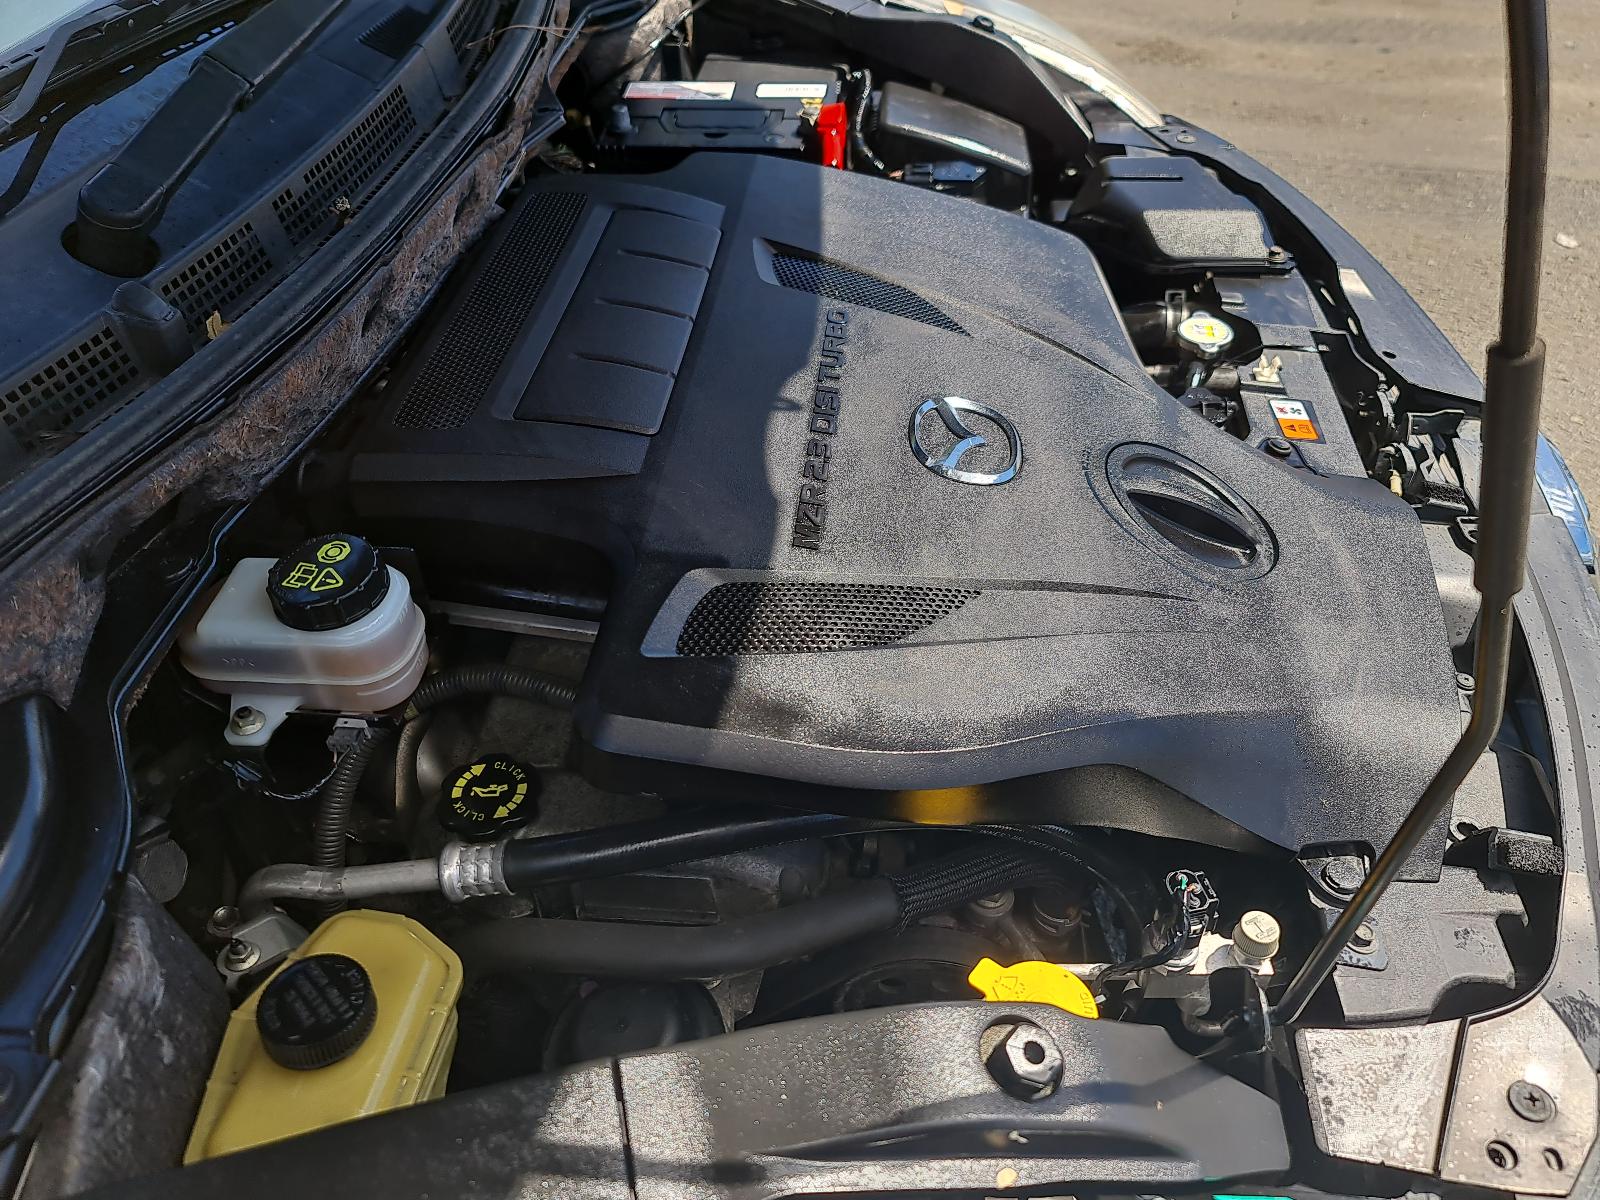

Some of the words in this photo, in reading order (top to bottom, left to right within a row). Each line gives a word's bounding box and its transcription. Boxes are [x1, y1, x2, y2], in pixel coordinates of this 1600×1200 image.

[818, 308, 848, 383] TURBO
[811, 385, 841, 435] DISI
[792, 484, 827, 551] MZR
[494, 761, 526, 780] CLICK
[453, 800, 485, 821] CLICK
